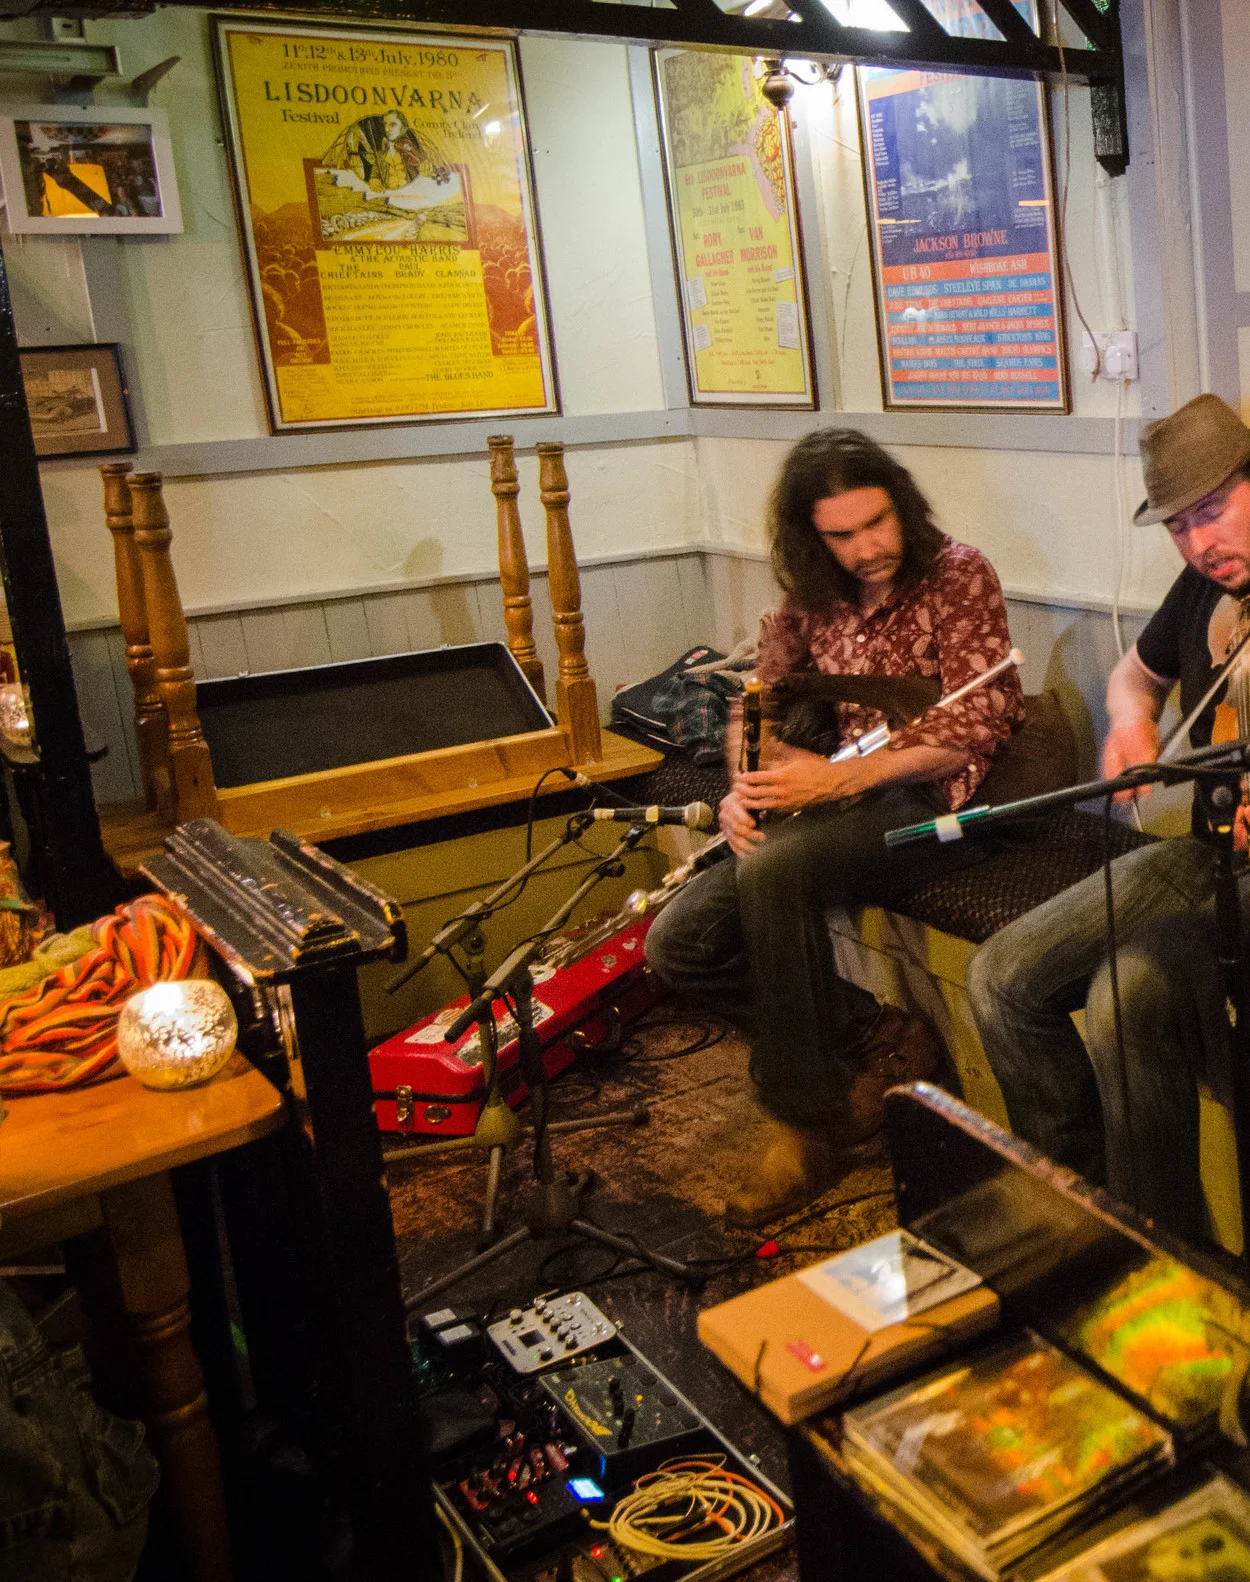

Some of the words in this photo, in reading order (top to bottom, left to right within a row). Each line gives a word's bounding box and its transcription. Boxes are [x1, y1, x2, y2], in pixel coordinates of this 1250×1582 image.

[263, 80, 484, 114] LISDOONVARNA
[280, 108, 341, 125] Festival
[697, 161, 746, 184] LISDOONVARNA
[702, 183, 732, 200] FESTIVAL
[703, 231, 722, 248] RORY
[748, 226, 764, 241] VAN
[913, 234, 958, 253] JACKSON
[963, 228, 1009, 249] BROWNE
[333, 245, 401, 256] EMMYLOU
[410, 244, 461, 256] HARRIS
[740, 244, 778, 262] MORRISON
[432, 255, 458, 263] BAND
[695, 249, 735, 268] GALLAGHER
[395, 270, 425, 279] BRADY
[399, 263, 421, 271] PAUL
[435, 270, 477, 279] CLANNAD
[902, 267, 918, 281] UB
[969, 261, 1008, 275] WISHBONE
[1010, 259, 1027, 272] ASH
[320, 271, 384, 280] CHIEFTAINS
[887, 285, 905, 298] DAVE
[943, 280, 981, 294] STEELEYE
[982, 279, 1002, 291] SPAN
[425, 373, 441, 382] THE
[444, 372, 471, 381] BLUES
[472, 370, 494, 381] BAND
